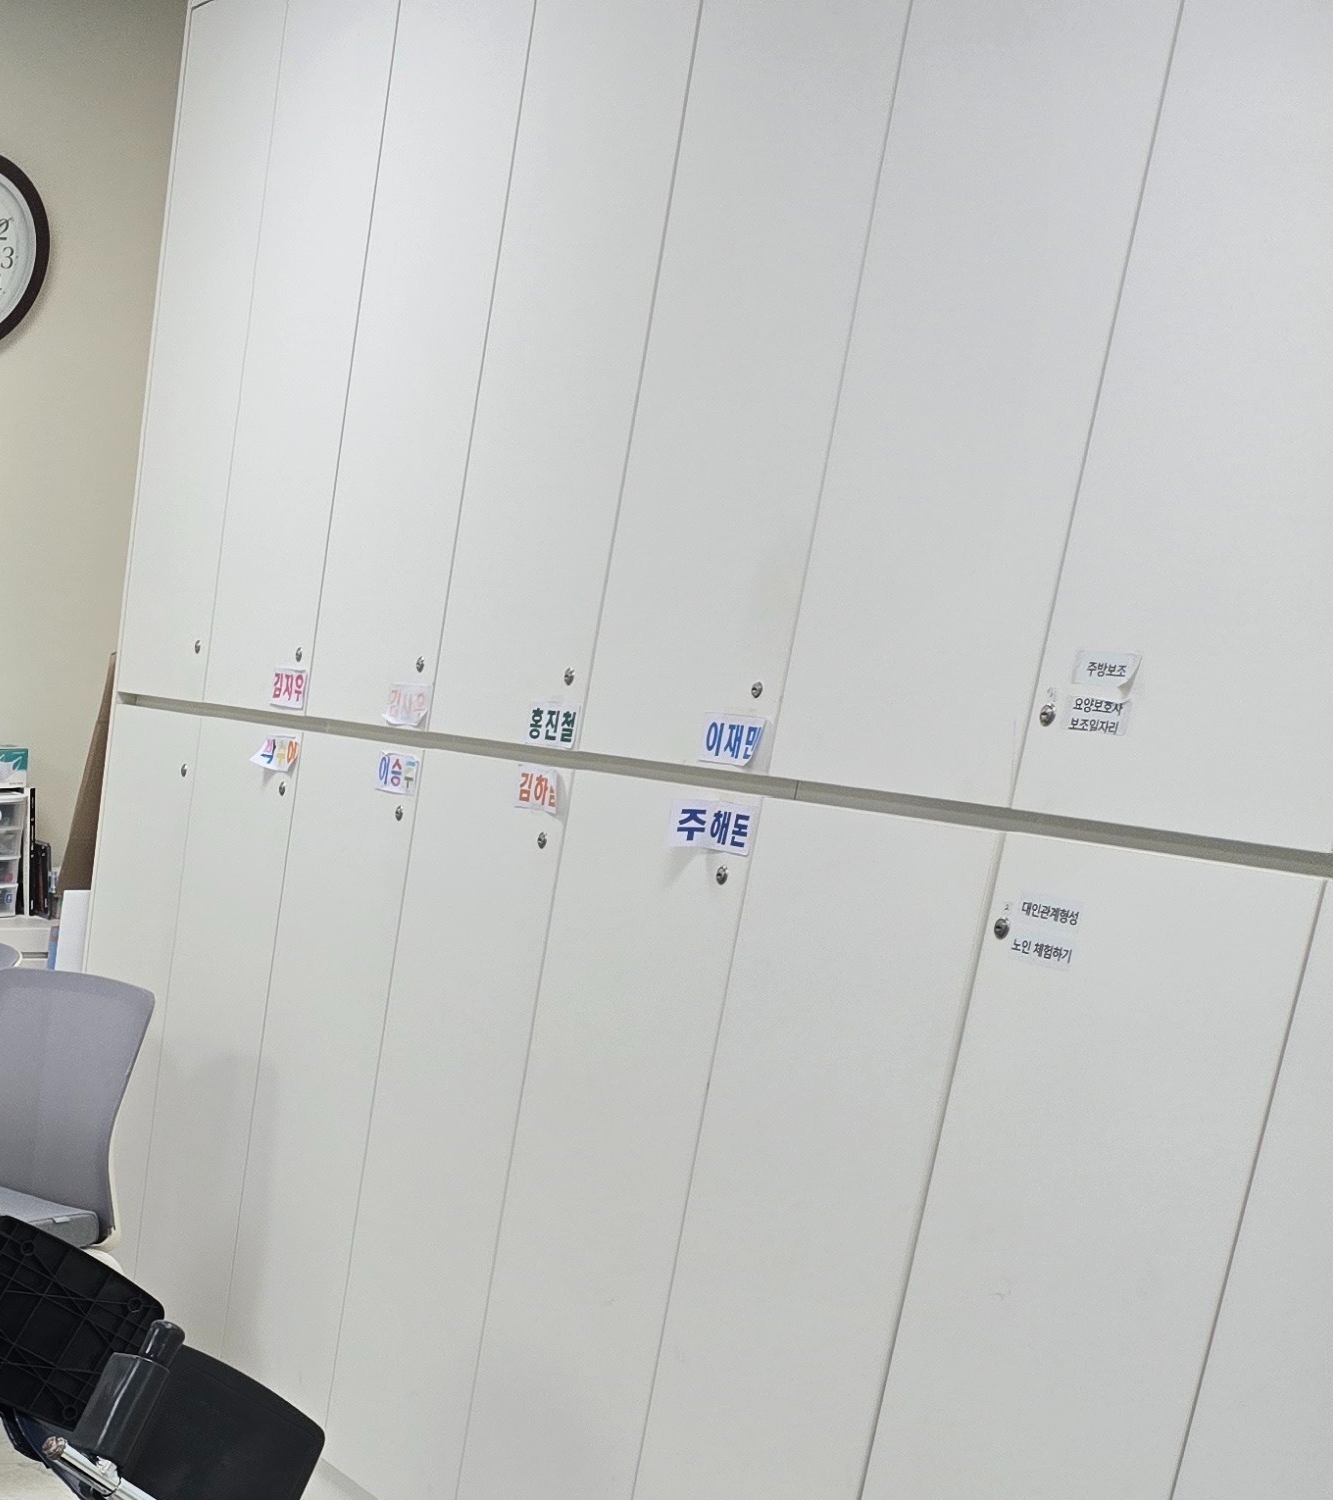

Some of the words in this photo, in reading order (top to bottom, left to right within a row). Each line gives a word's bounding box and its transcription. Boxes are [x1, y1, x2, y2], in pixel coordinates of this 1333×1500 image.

[0, 246, 14, 269] 3
[1086, 661, 1127, 677] 주방보조
[272, 672, 304, 702] 김지우
[1072, 698, 1124, 716] 요양보호사
[529, 707, 577, 743] 홍진철
[705, 721, 762, 760] 이재민
[677, 808, 750, 848] 주해돈
[1021, 901, 1080, 926] 대인관계형성
[1011, 939, 1032, 954] 노인
[1033, 942, 1073, 964] 체험하기
